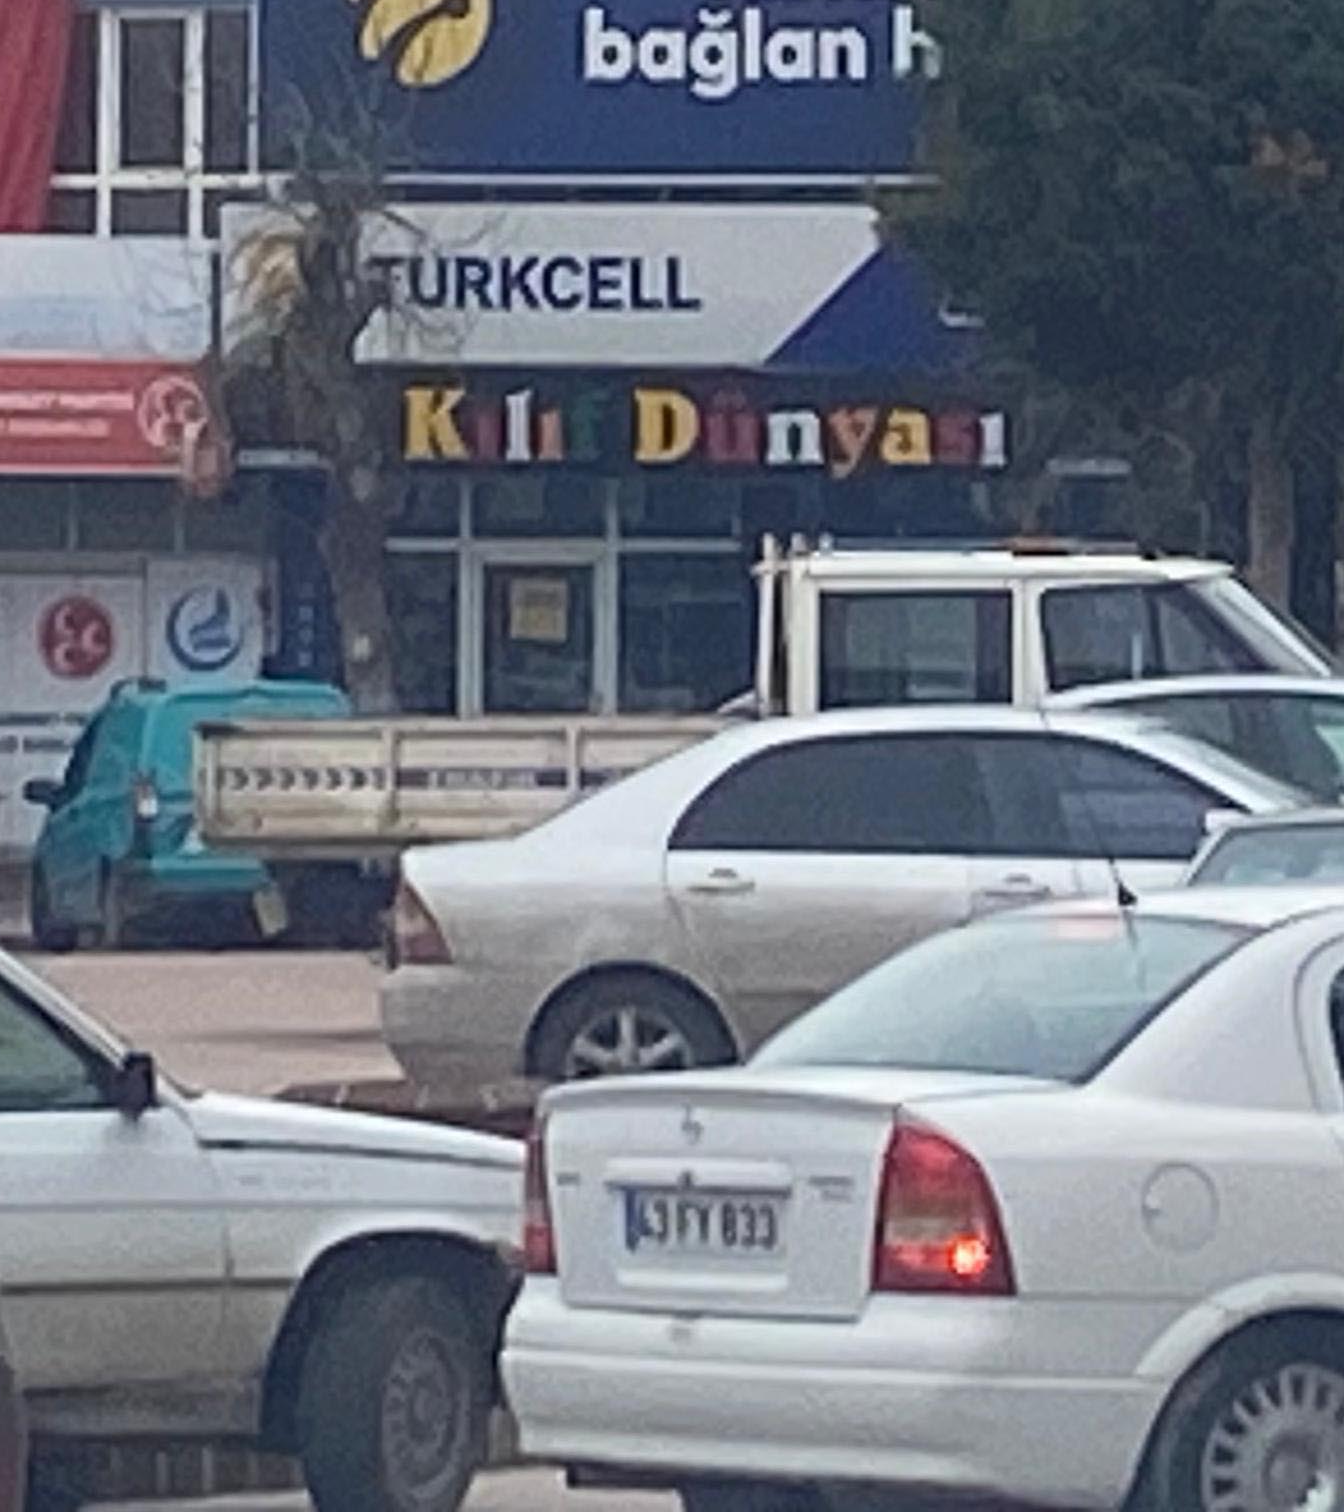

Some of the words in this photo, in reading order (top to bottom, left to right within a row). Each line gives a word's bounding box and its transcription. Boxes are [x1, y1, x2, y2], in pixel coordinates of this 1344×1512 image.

[584, 5, 867, 101] bağlan
[367, 255, 703, 312] TURKCELL
[632, 386, 1007, 479] Dünyası
